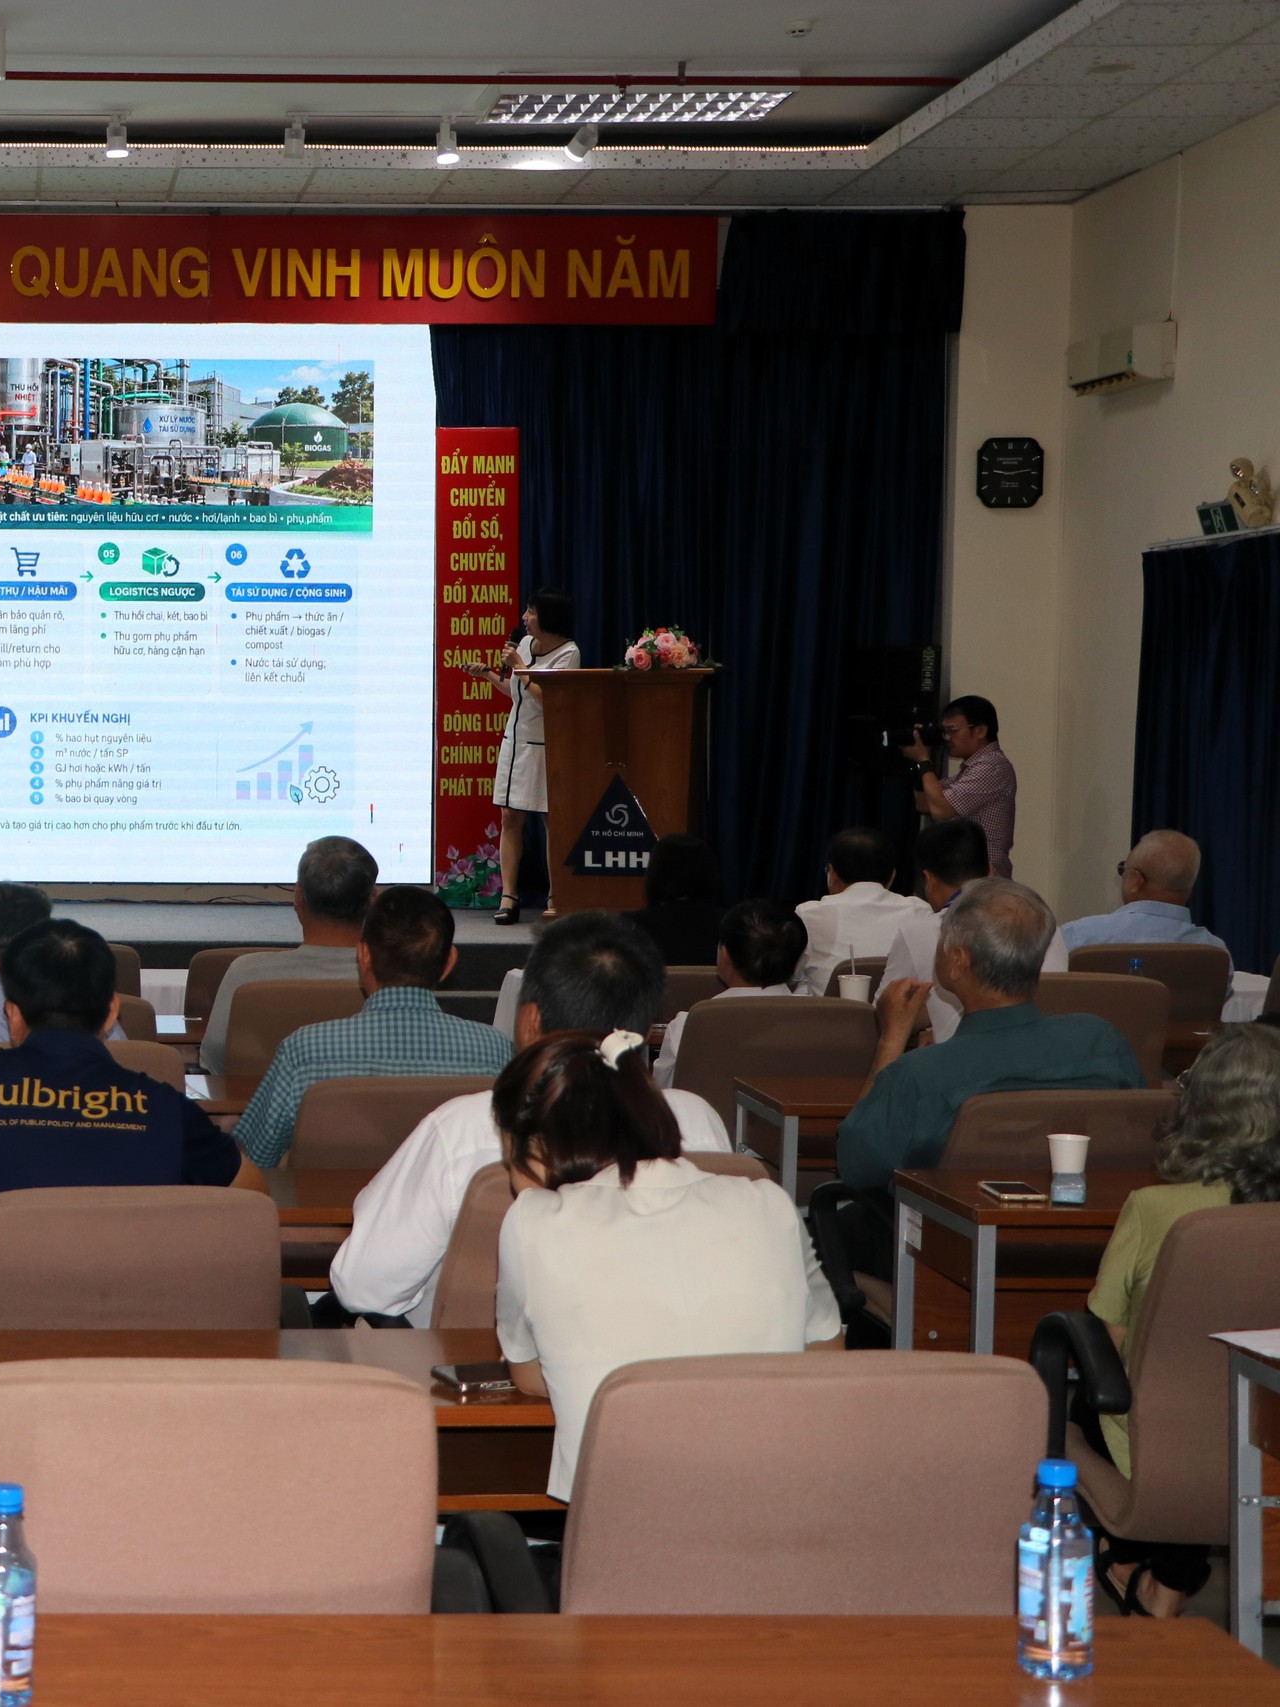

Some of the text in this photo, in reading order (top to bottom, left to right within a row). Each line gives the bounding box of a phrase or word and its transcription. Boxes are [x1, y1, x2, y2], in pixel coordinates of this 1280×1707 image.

[10, 245, 209, 299] QUANG
[232, 247, 362, 299] VINH
[381, 232, 545, 299] MUÔN
[567, 234, 691, 299] NĂM
[304, 443, 332, 453] BIOGAS
[440, 447, 515, 479] ĐẨY MẠNH
[449, 480, 506, 507] CHUYỂN
[452, 512, 504, 541] ĐỔI SỐ,
[102, 550, 115, 559] 05
[230, 550, 243, 560] 06
[449, 545, 506, 572] CHUYỂN
[0, 586, 20, 597] THỤ
[27, 585, 50, 597] HẬU
[51, 585, 69, 596] MÃI
[108, 587, 196, 599] LOGISTICS NGƯỢC
[231, 586, 245, 597] TÁI
[247, 585, 261, 598] SỬ
[262, 588, 288, 600] DỤNG
[295, 586, 323, 600] CỘNG
[324, 588, 347, 598] SINH
[442, 577, 513, 605] ĐỔI XANH,
[450, 609, 506, 636] ĐỔI MỚI
[44, 644, 60, 653] cho
[246, 642, 283, 651] compost
[485, 648, 503, 672] TẠ
[462, 677, 493, 700] LÀM
[31, 710, 130, 725] KPI KHUYẾN NGHỊ
[442, 709, 482, 737] ĐỘNG
[440, 741, 483, 765] CHÍNH
[439, 773, 474, 797] PHÁT
[584, 850, 650, 868] LHH
[8, 1118, 19, 1126] OF
[20, 1118, 47, 1127] PUBLIC
[47, 1120, 75, 1128] POLICY
[92, 1121, 147, 1131] MANAGEMENT
